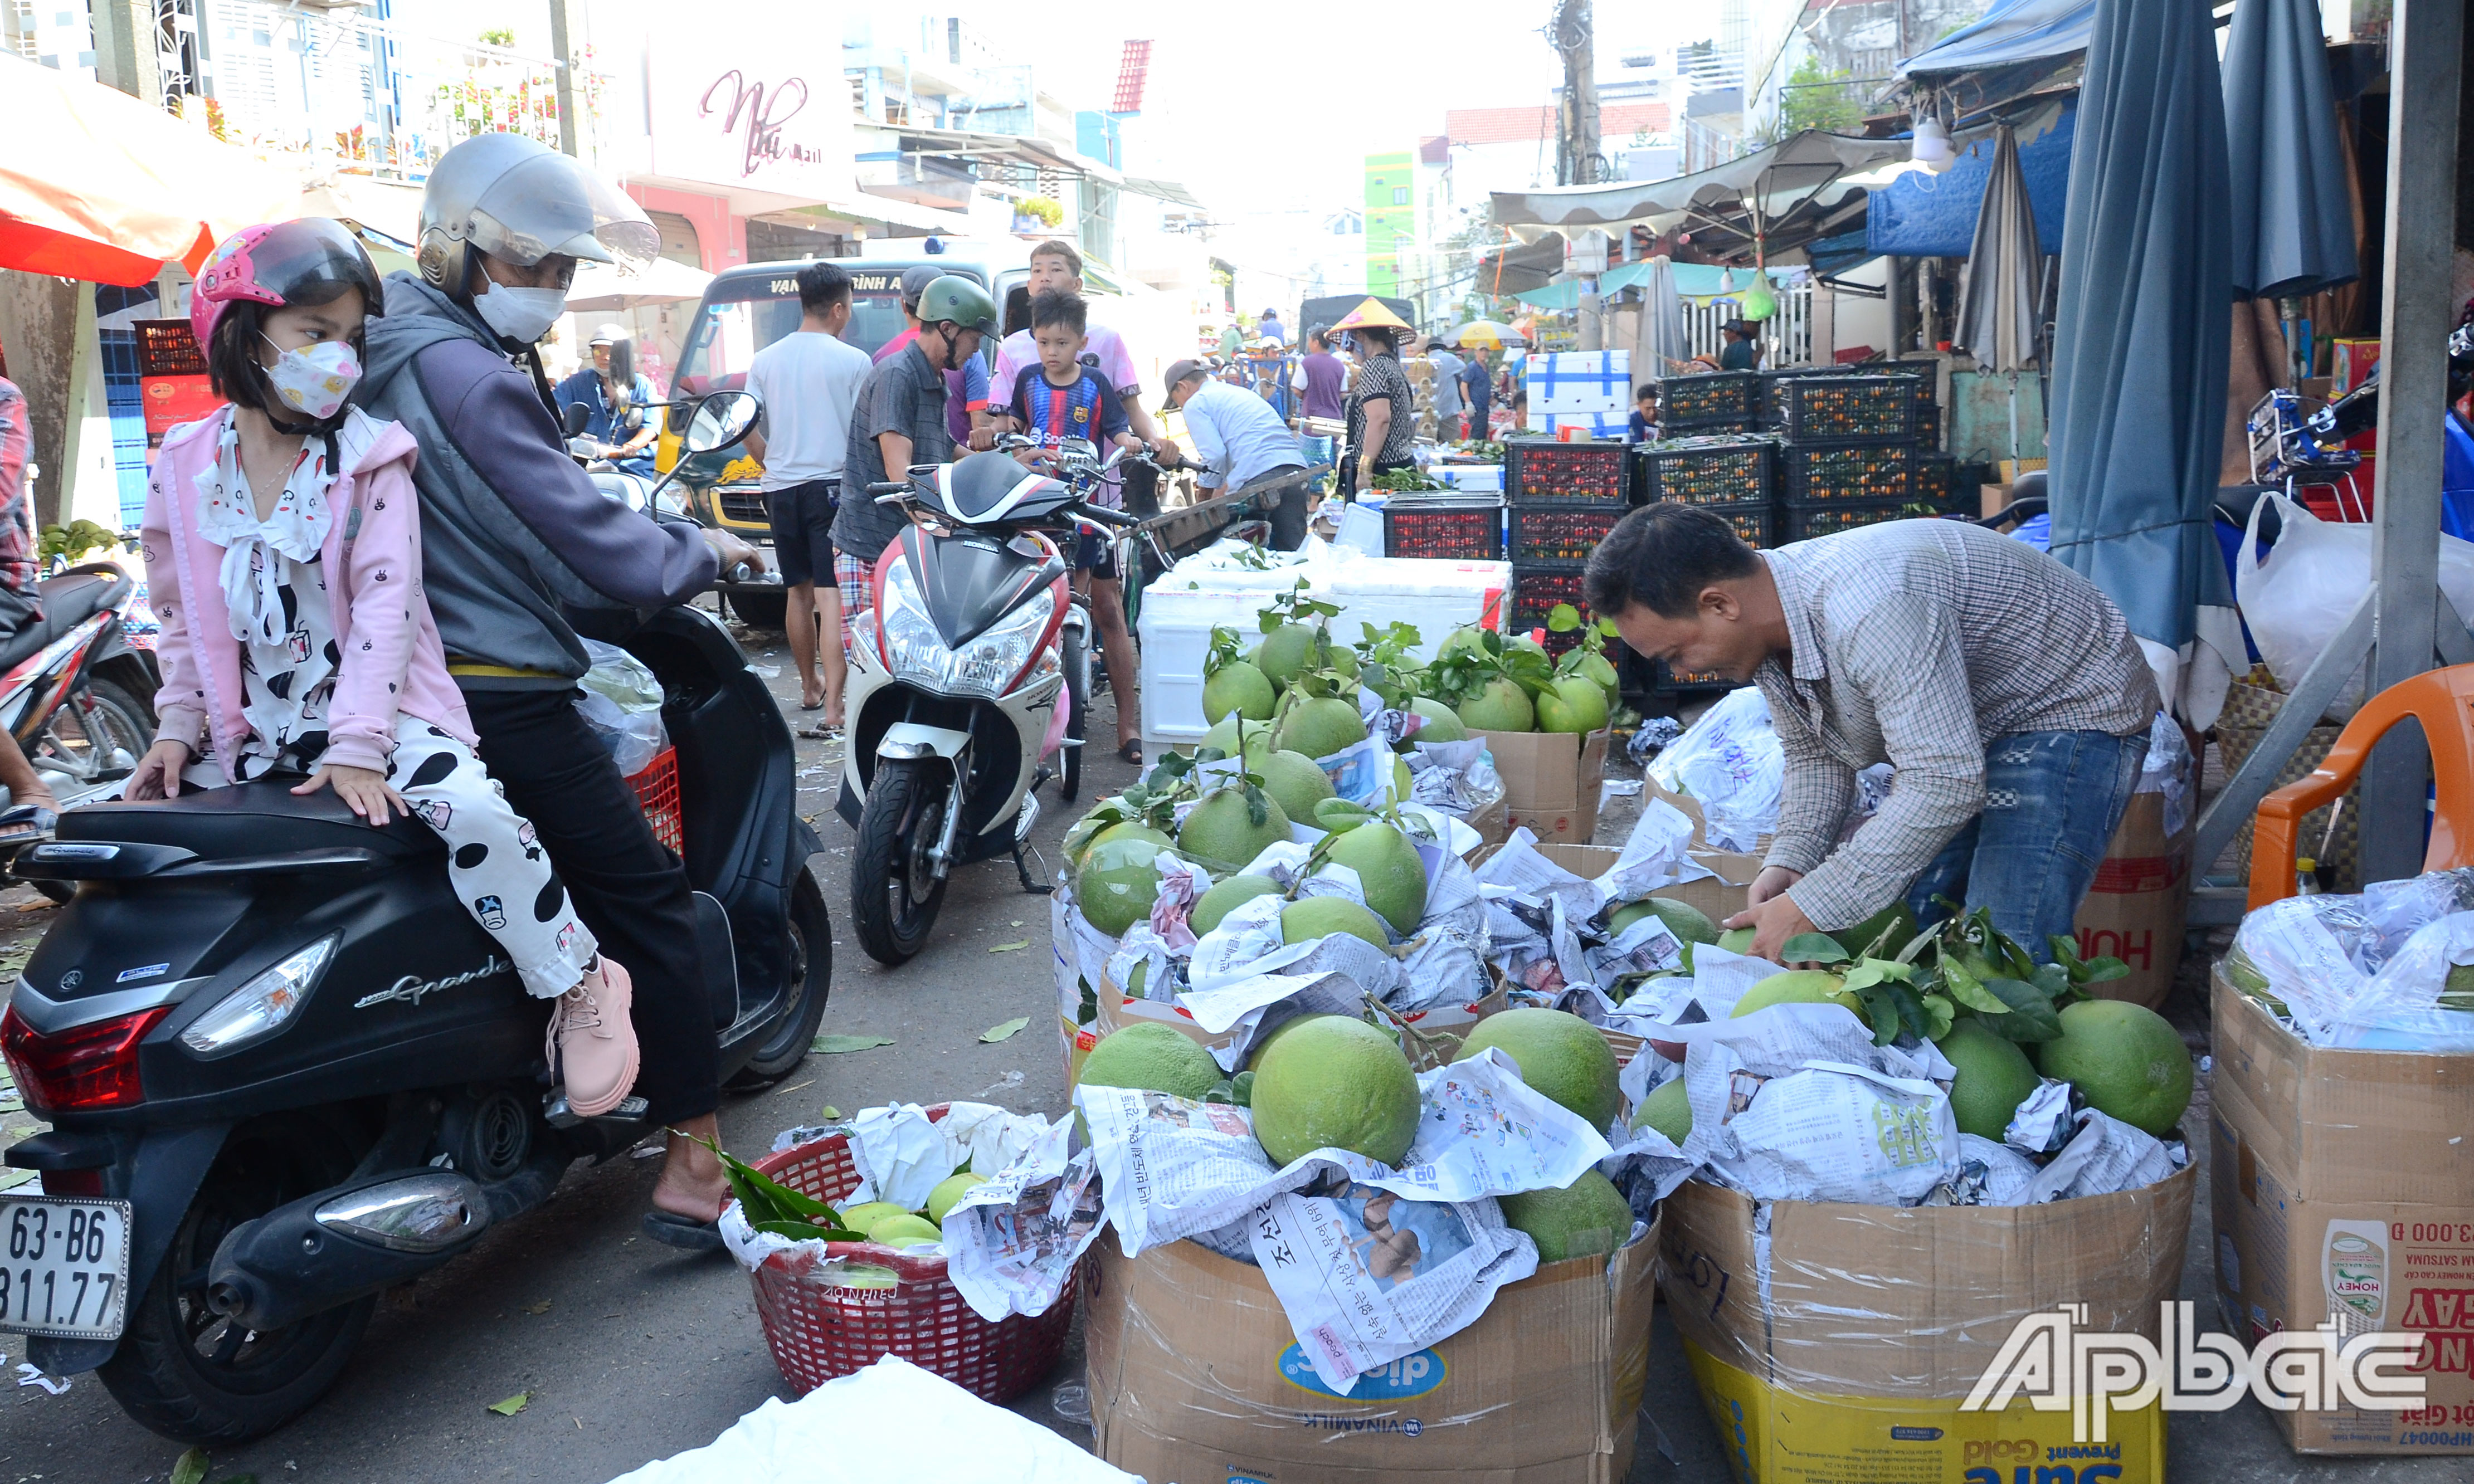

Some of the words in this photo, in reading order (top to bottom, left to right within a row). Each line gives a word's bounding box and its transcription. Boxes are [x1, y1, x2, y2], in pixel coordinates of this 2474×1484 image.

[851, 274, 887, 290] BÌNH
[889, 277, 901, 290] A
[963, 540, 999, 553] HONDA
[391, 955, 513, 1005] Grande
[1131, 1148, 1148, 1183] 반도체
[10, 1207, 106, 1263] 63-B6
[1314, 1223, 1336, 1248] 무역
[1328, 1248, 1345, 1263] 첫
[2406, 1254, 2458, 1266] SATSUMA
[2336, 1282, 2379, 1292] HOMEY
[1355, 1290, 1375, 1316] 없는
[1366, 1317, 1387, 1341] 실속
[1319, 1327, 1343, 1359] peach
[1303, 1414, 1400, 1433] VINAMILK
[1962, 1438, 2039, 1465] Gold
[2046, 1443, 2121, 1461] Prevent
[1235, 1466, 1274, 1479] VINAMILK
